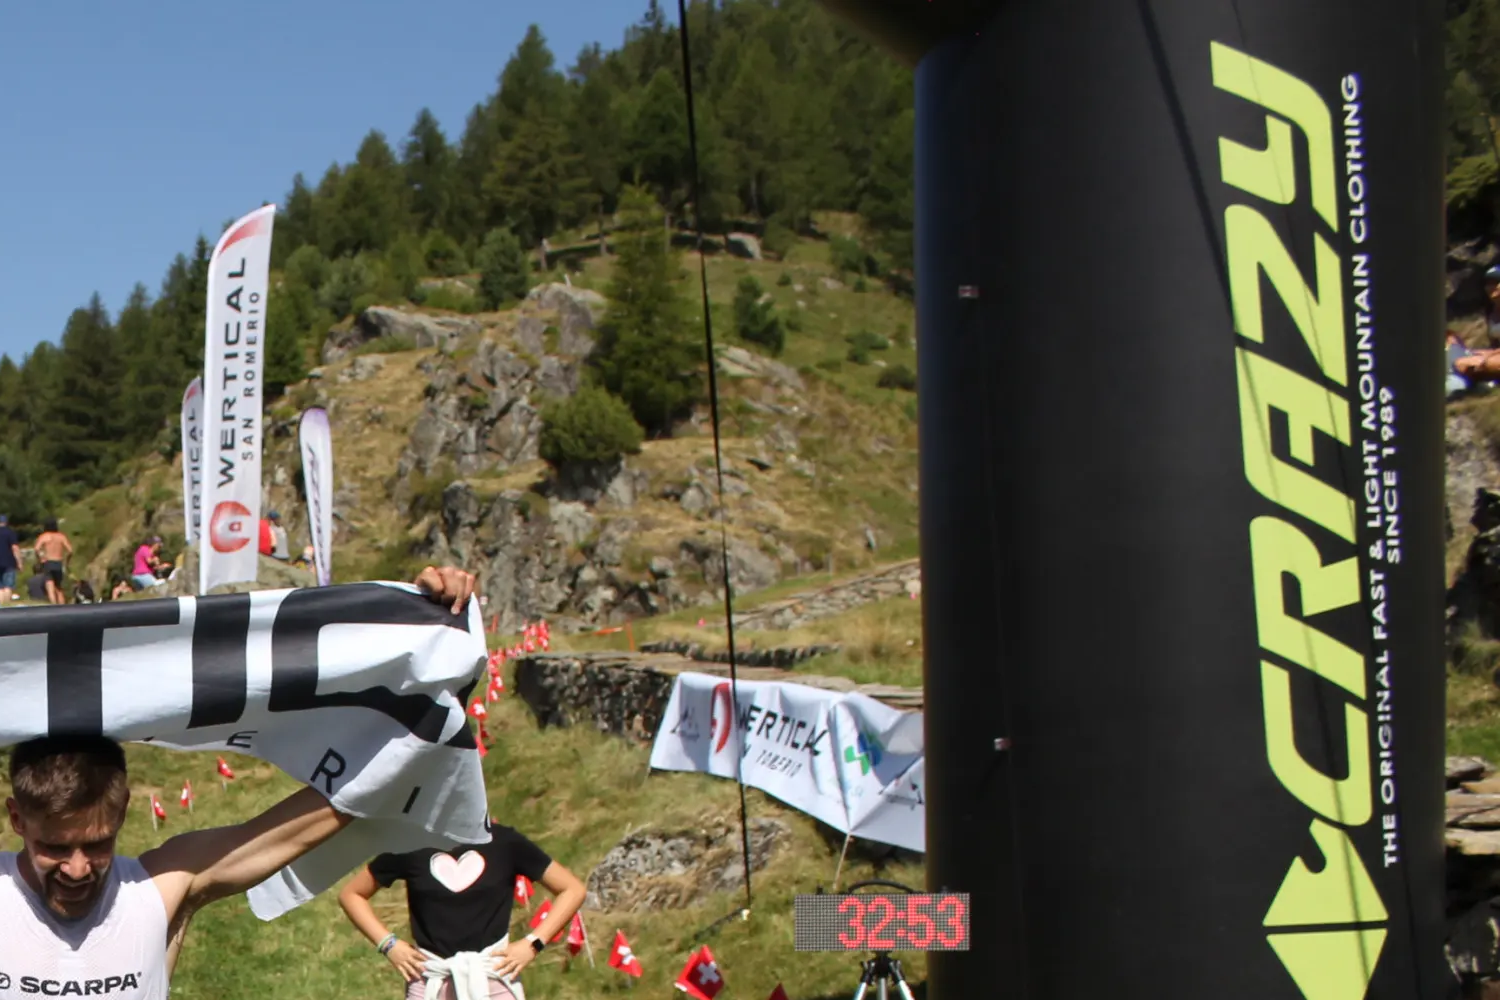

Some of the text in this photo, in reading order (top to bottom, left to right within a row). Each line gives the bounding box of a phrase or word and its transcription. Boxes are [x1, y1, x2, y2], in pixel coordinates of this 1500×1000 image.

[217, 257, 246, 489] WERTICAL
[242, 291, 260, 461] SAN ROMERIO
[1211, 41, 1373, 826] CRAZY
[1341, 73, 1398, 868] THE ORIGINAL FAST & LIGHT MOUNTAIN CLOTHING
[1379, 386, 1401, 564] SINCE 1989
[20, 973, 139, 996] SCARPA
[837, 896, 966, 950] 32:53
